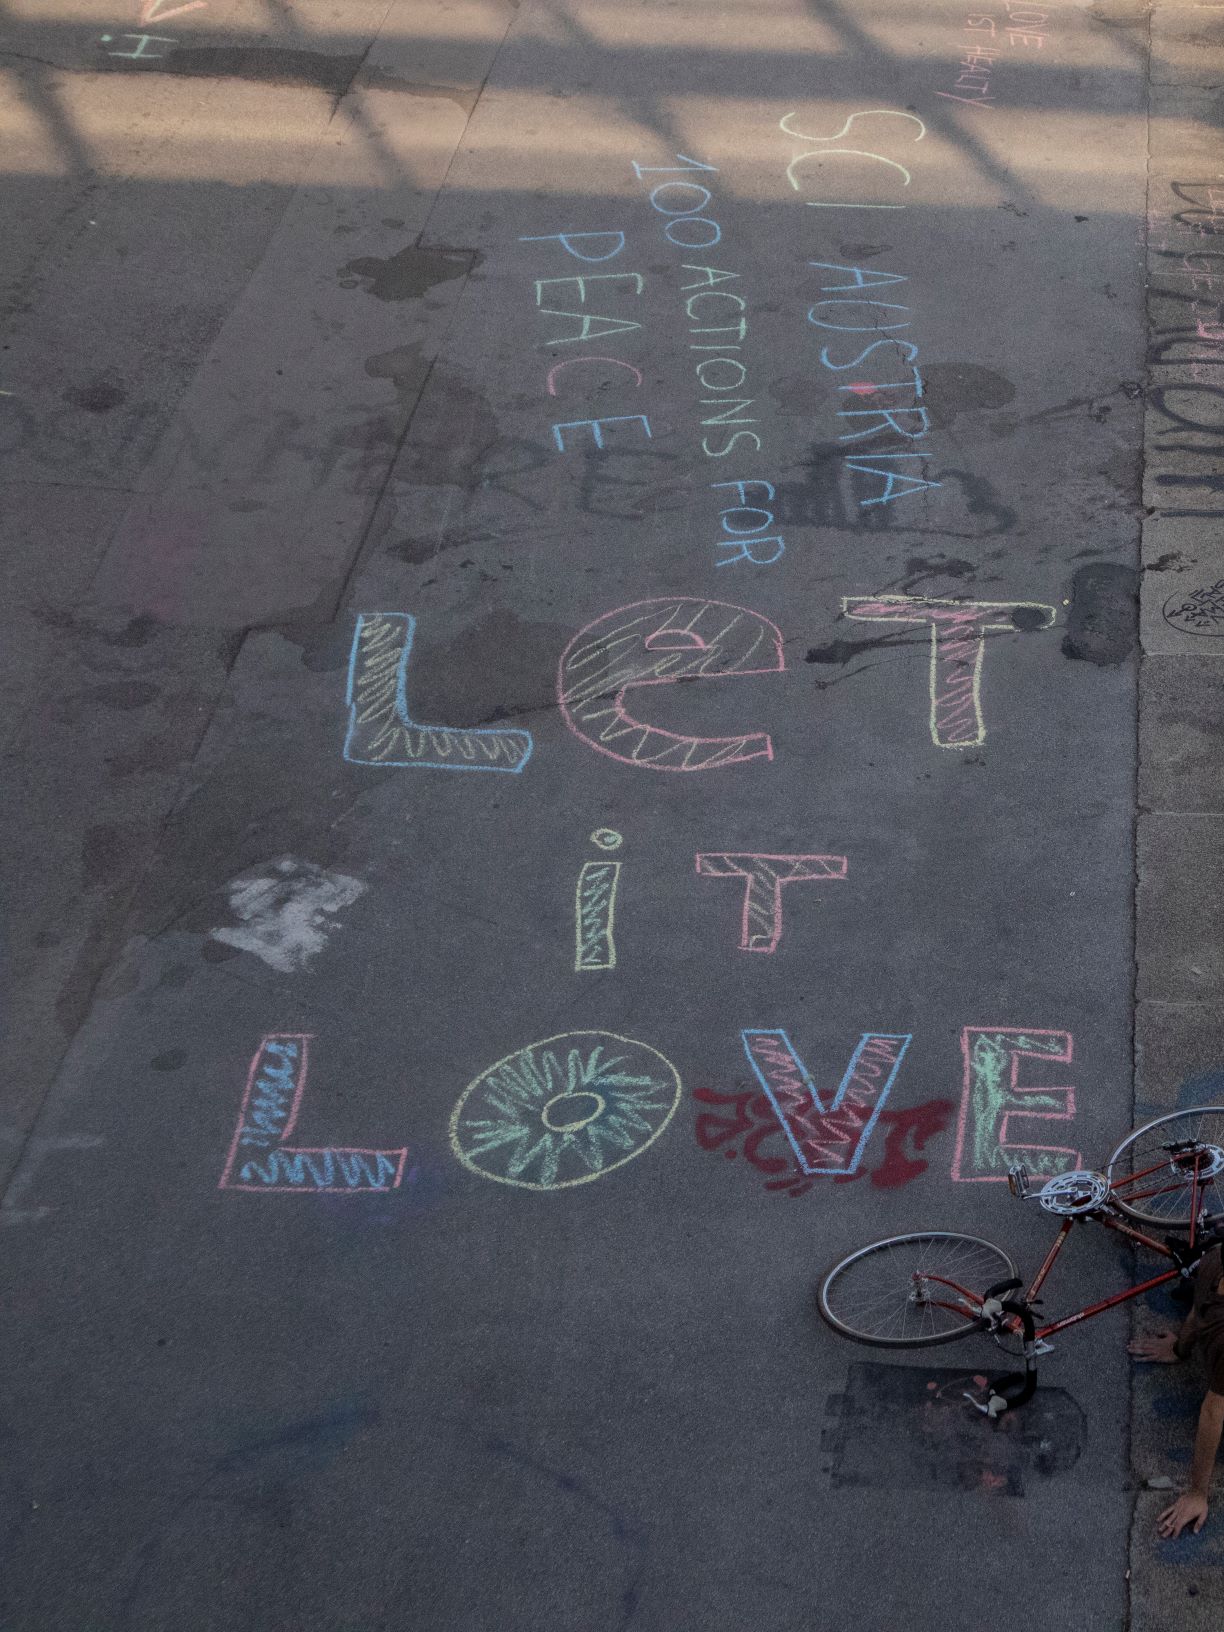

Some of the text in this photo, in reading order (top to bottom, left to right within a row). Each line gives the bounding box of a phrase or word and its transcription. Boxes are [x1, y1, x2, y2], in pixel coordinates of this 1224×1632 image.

[1004, 0, 1058, 49] LOVE
[518, 230, 653, 454] PEACE
[631, 153, 786, 568] 100 ACTIONS FOR
[779, 109, 944, 507] SCI AUSTRIA
[216, 1025, 1084, 1193] LOVE
